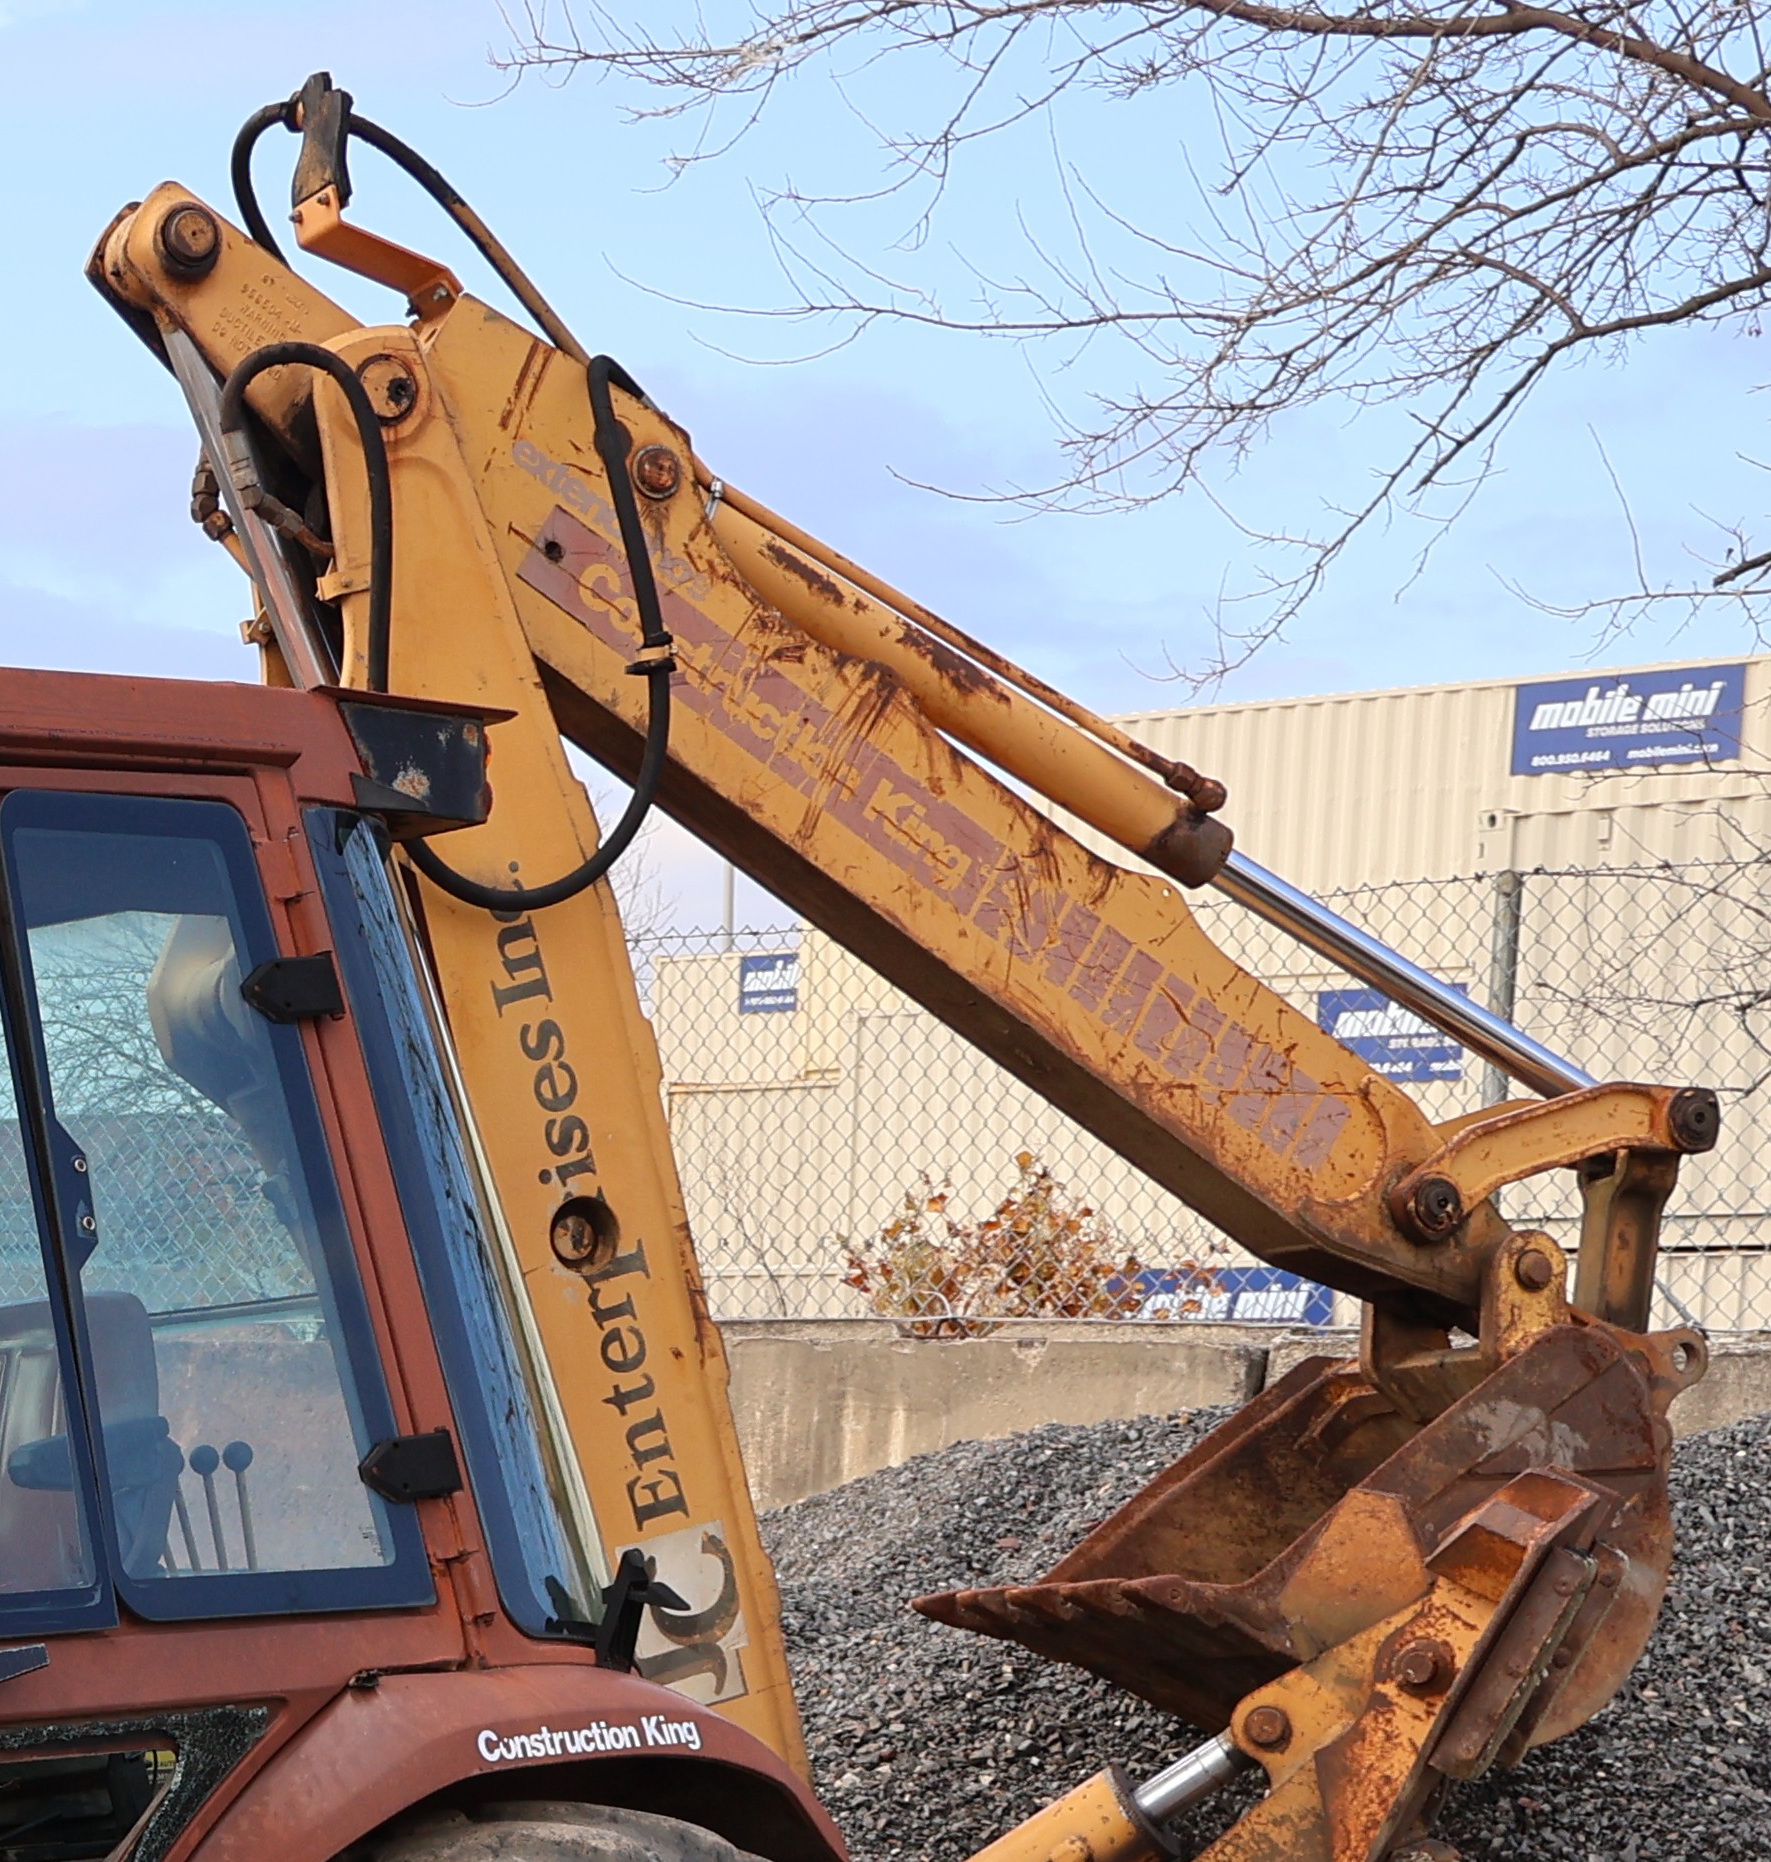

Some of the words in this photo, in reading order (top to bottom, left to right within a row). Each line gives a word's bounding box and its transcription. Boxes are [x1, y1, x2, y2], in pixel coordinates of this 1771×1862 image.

[1529, 684, 1643, 731] mobile
[1642, 681, 1723, 721] mini
[863, 777, 972, 891] King
[1232, 1284, 1310, 1319] mini
[477, 1720, 642, 1762] Construction
[641, 1715, 701, 1750] King
